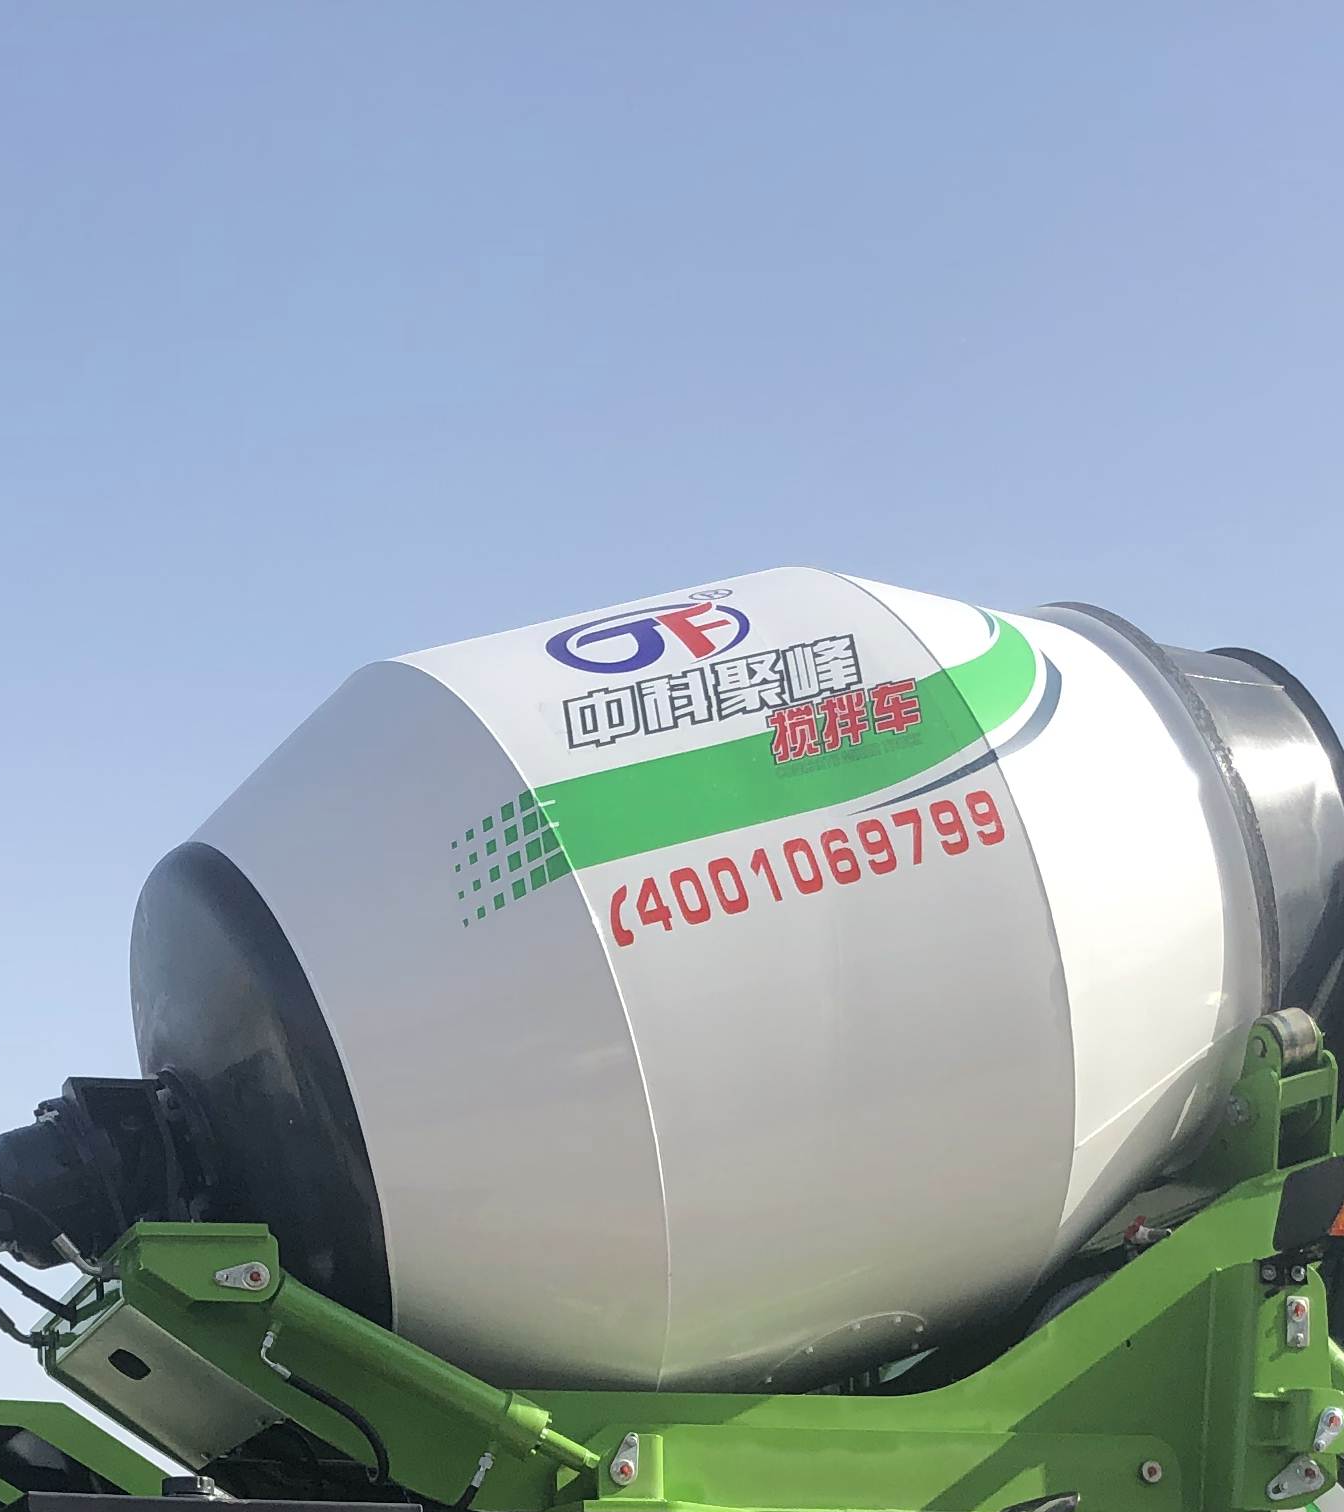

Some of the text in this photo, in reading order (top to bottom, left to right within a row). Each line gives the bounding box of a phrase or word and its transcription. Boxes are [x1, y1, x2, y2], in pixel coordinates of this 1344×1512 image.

[563, 635, 862, 750] 中科聚峰
[769, 678, 922, 764] 搅拌车
[638, 790, 1006, 932] 4001069799
